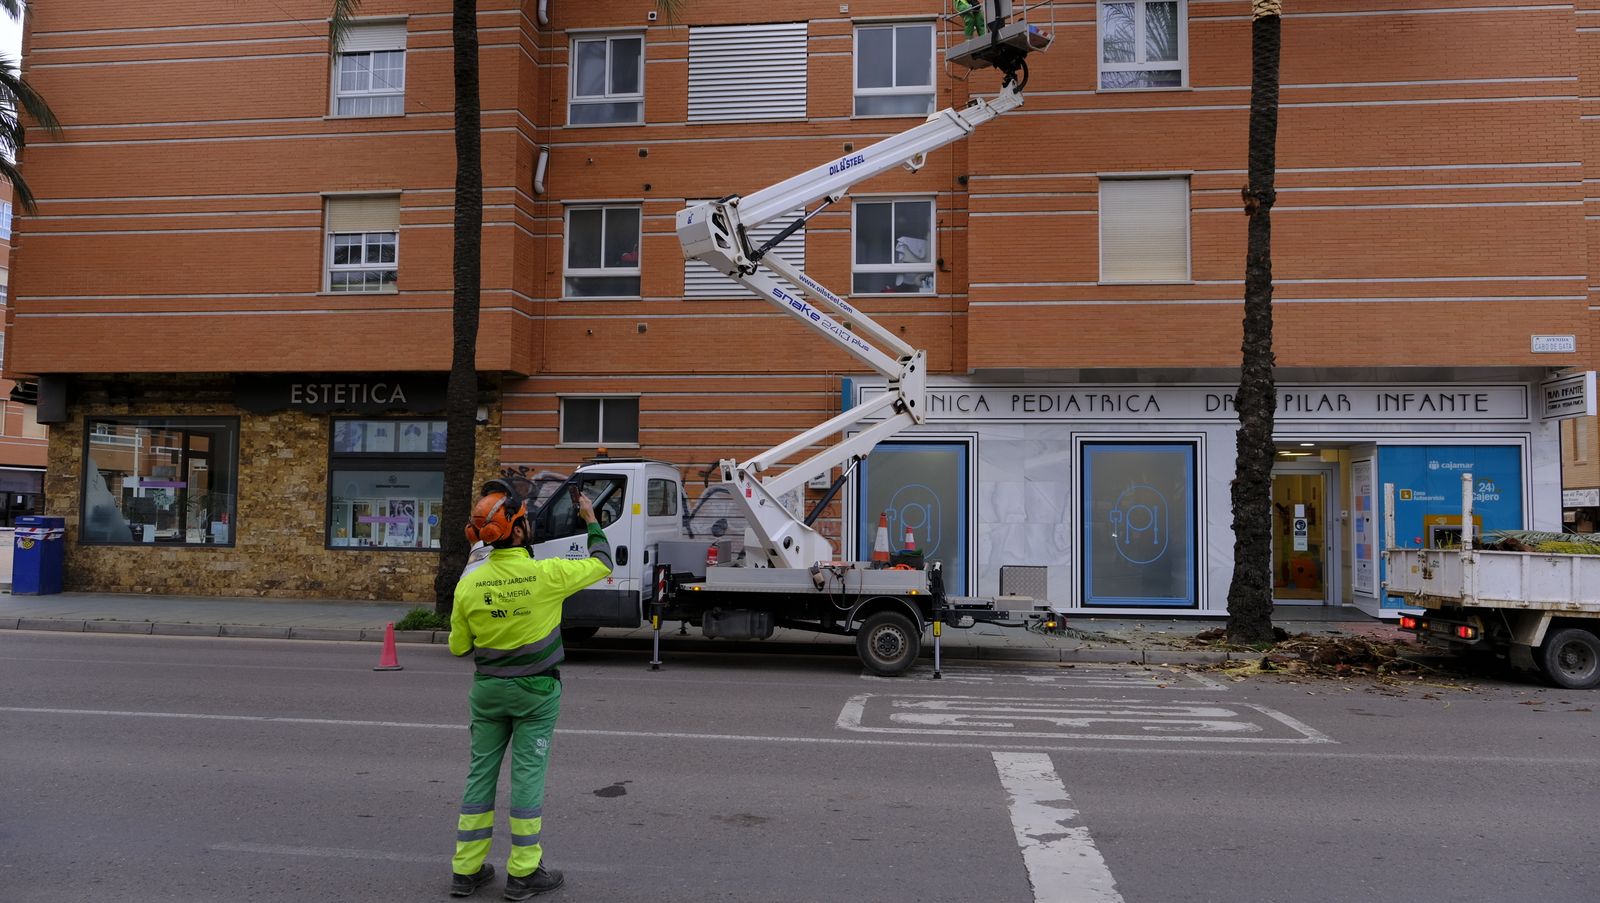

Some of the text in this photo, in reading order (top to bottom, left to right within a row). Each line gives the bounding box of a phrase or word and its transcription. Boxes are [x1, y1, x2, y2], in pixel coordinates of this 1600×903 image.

[798, 274, 853, 314] www.oilsteel.com
[772, 287, 821, 322] snake
[850, 337, 870, 352] plus
[291, 383, 407, 404] ESTETICA
[925, 394, 990, 412] INICA
[1011, 394, 1161, 413] PEDIATRICA
[1284, 394, 1351, 412] PILAR
[1376, 393, 1488, 412] INFANTE
[1441, 462, 1474, 470] cajamar
[475, 580, 503, 588] PARQUES
[507, 575, 537, 585] JARDINES
[498, 589, 531, 598] ALMERÍA
